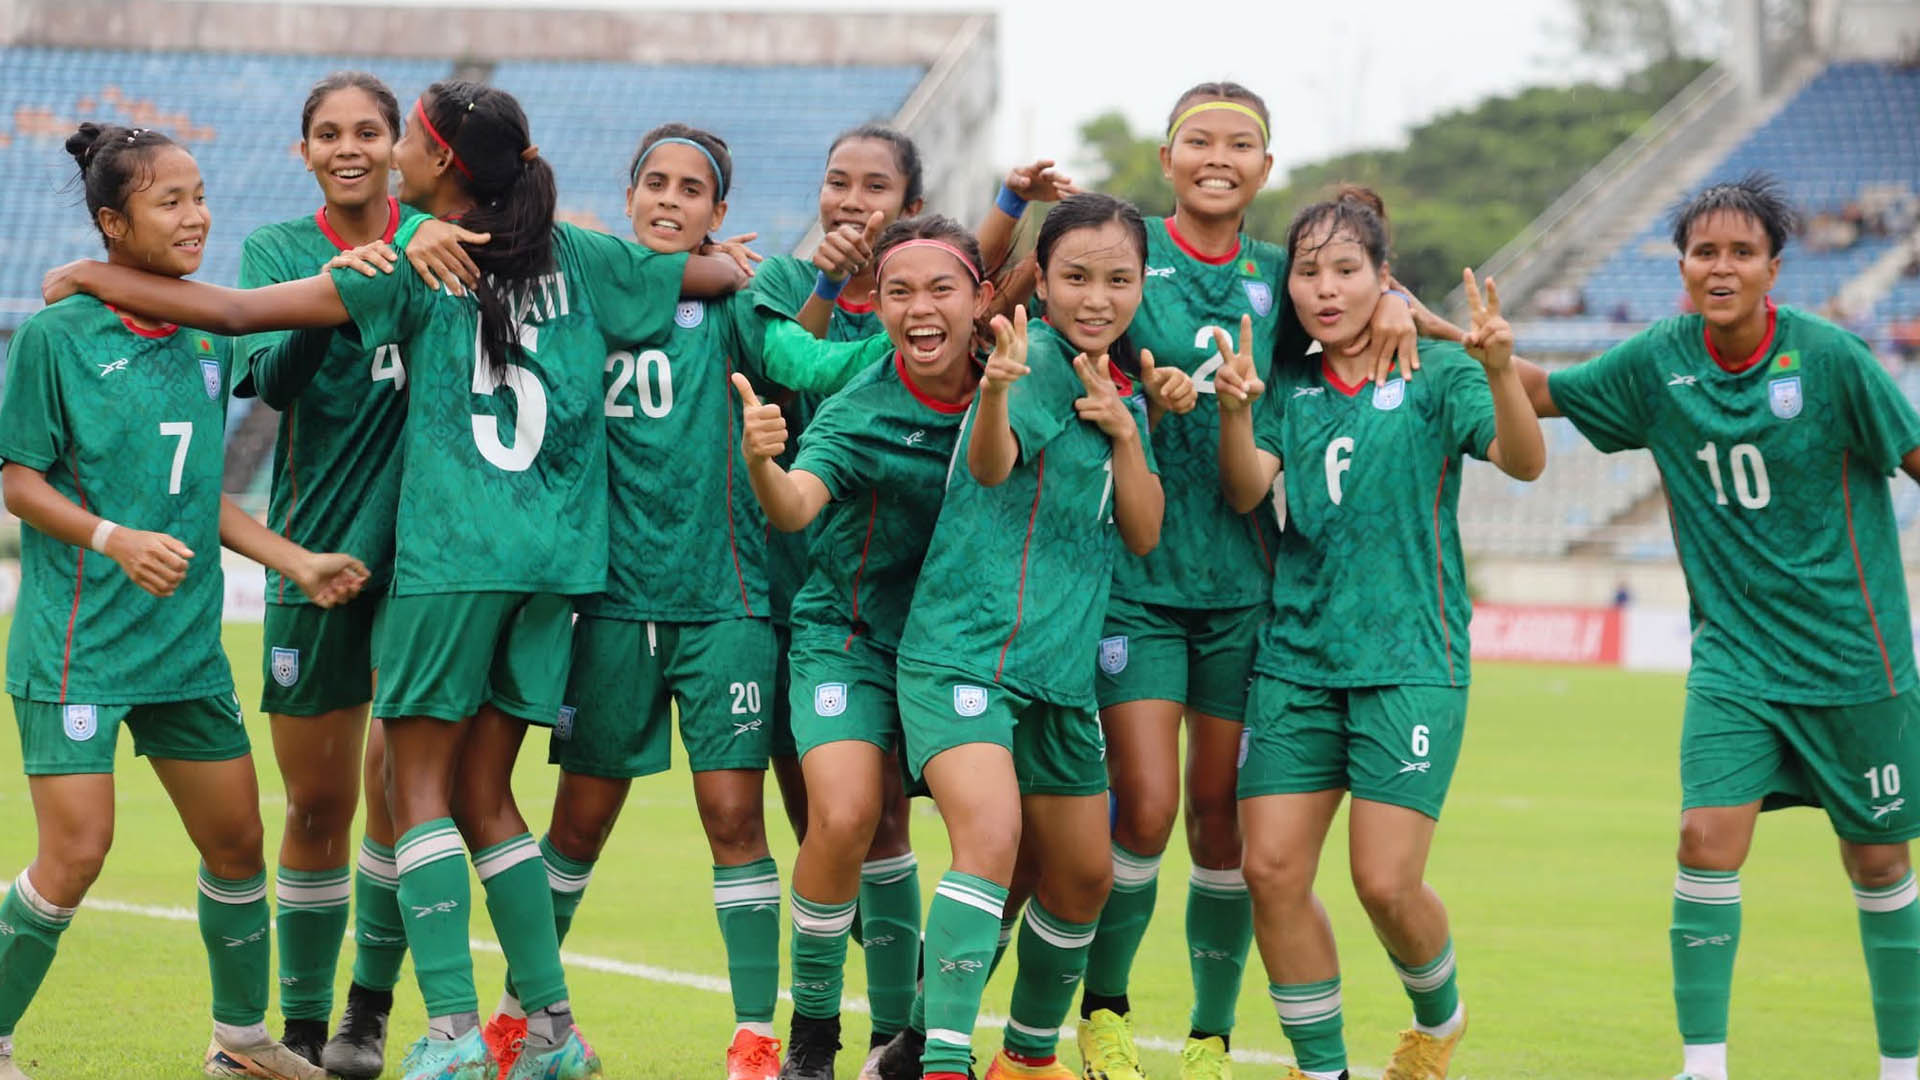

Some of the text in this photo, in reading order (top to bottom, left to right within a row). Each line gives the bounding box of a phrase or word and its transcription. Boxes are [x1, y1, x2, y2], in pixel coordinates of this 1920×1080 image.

[371, 344, 406, 391] 4
[471, 310, 547, 472] 5
[604, 350, 674, 418] 20
[1191, 325, 1234, 394] 2
[160, 422, 193, 494] 7
[1696, 441, 1771, 510] 10
[729, 681, 761, 714] 20
[1412, 724, 1430, 757] 6
[1864, 764, 1901, 798] 10
